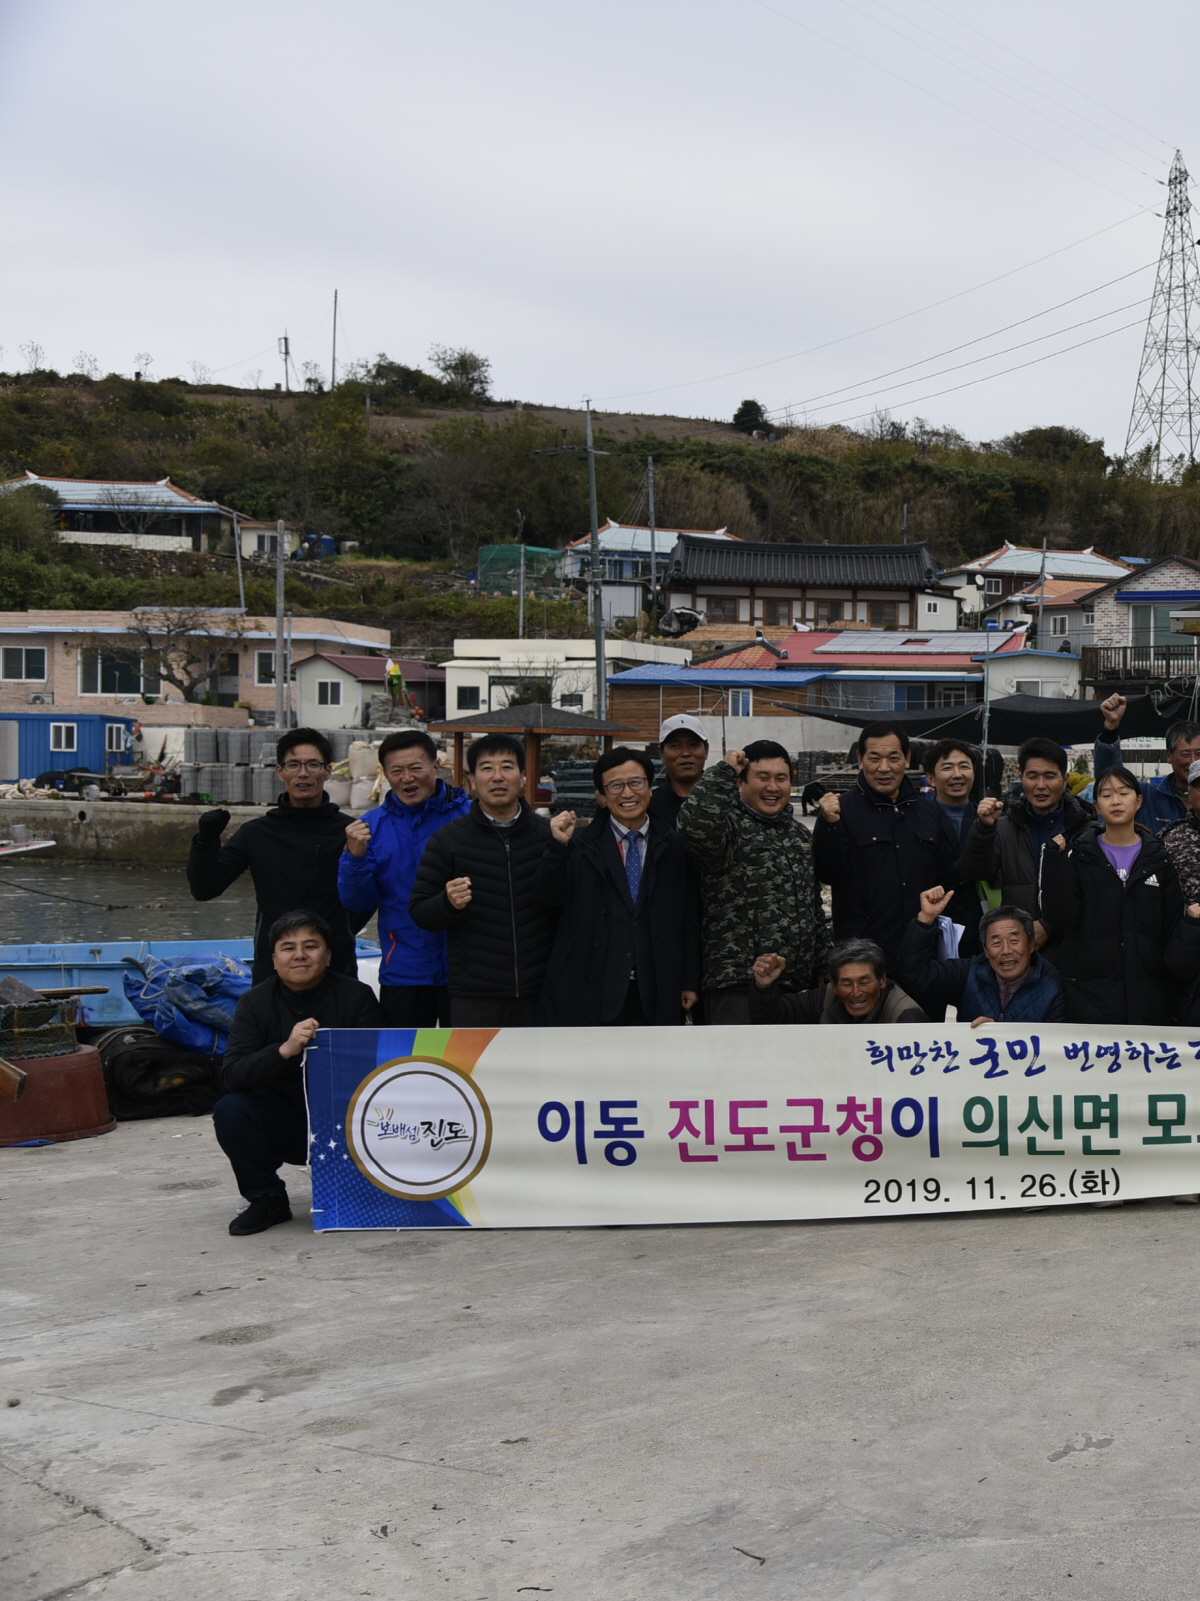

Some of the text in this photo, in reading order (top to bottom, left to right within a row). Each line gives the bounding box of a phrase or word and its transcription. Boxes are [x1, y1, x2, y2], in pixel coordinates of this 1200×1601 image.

[866, 1039, 960, 1076] 희망찬
[969, 1035, 1047, 1079] 군민
[1063, 1040, 1182, 1074] 번영하는
[377, 1118, 469, 1148] 보배섬 진도
[537, 1100, 645, 1167] 이동
[667, 1096, 940, 1163] 진도군청이
[961, 1093, 1122, 1156] 의신면
[863, 1178, 950, 1204] 2019.
[965, 1176, 1007, 1201] 11.
